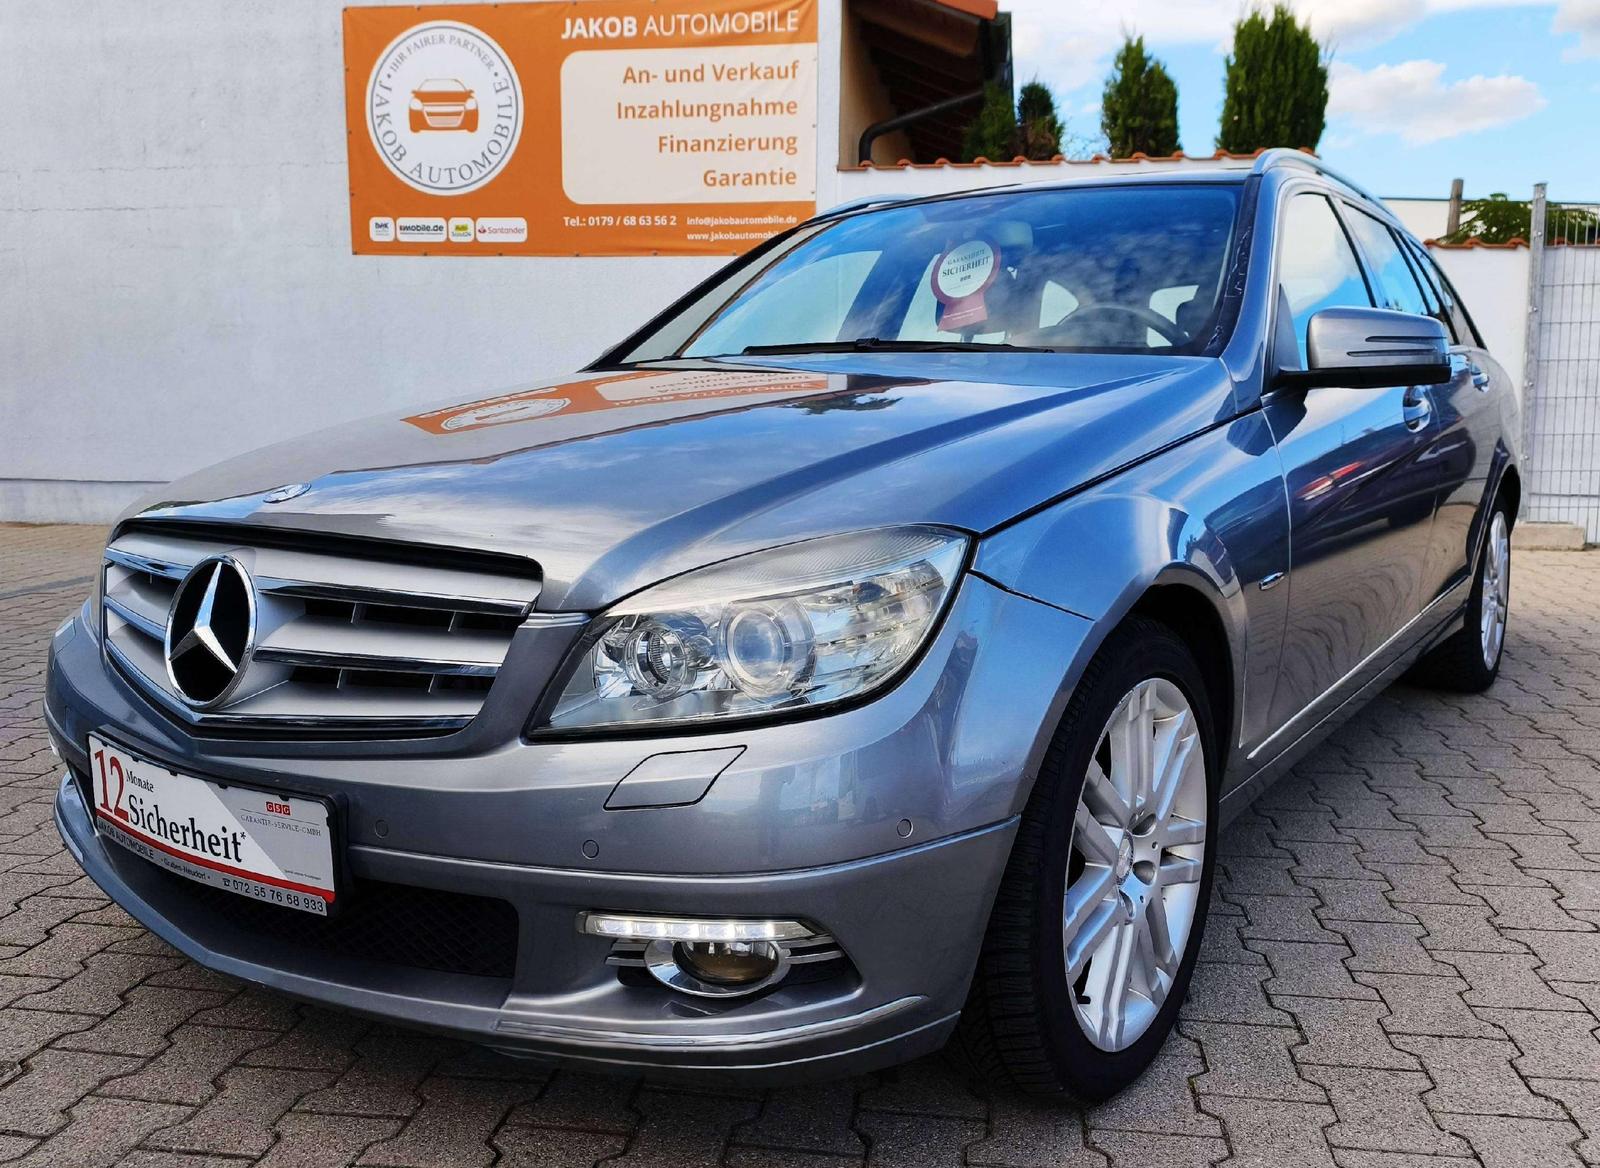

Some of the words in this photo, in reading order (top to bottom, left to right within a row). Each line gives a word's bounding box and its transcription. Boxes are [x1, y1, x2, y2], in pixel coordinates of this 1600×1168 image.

[561, 16, 637, 40] JAKOB
[643, 9, 800, 37] AUTOMOBILE
[389, 51, 408, 73] IHR
[406, 34, 447, 55] FAIRER
[449, 34, 495, 70] PARTNER
[622, 65, 658, 84] An-
[664, 63, 706, 83] und
[712, 60, 800, 82] Verkauf
[616, 97, 798, 122] Inzahlungnahme
[375, 80, 408, 162] JAKOB
[410, 78, 513, 184] AUTOMOBILE
[658, 133, 798, 156] Finanzierung
[703, 167, 797, 187] Garantie
[487, 226, 526, 234] Santander
[563, 216, 586, 227] Tel.:
[588, 216, 614, 226] 0179
[623, 216, 636, 226] 68
[638, 216, 652, 226] 63
[654, 216, 668, 226] 56
[669, 216, 677, 226] 2
[687, 215, 797, 227] info@jakobautomobile.de
[942, 256, 991, 277] SICHERHEIT
[95, 750, 129, 822] 12
[126, 768, 154, 793] Monate
[266, 801, 291, 816] GSG
[233, 880, 250, 893] 072
[254, 886, 266, 898] 55
[270, 889, 283, 902] 76
[286, 894, 300, 906] 68
[303, 898, 324, 912] 933
